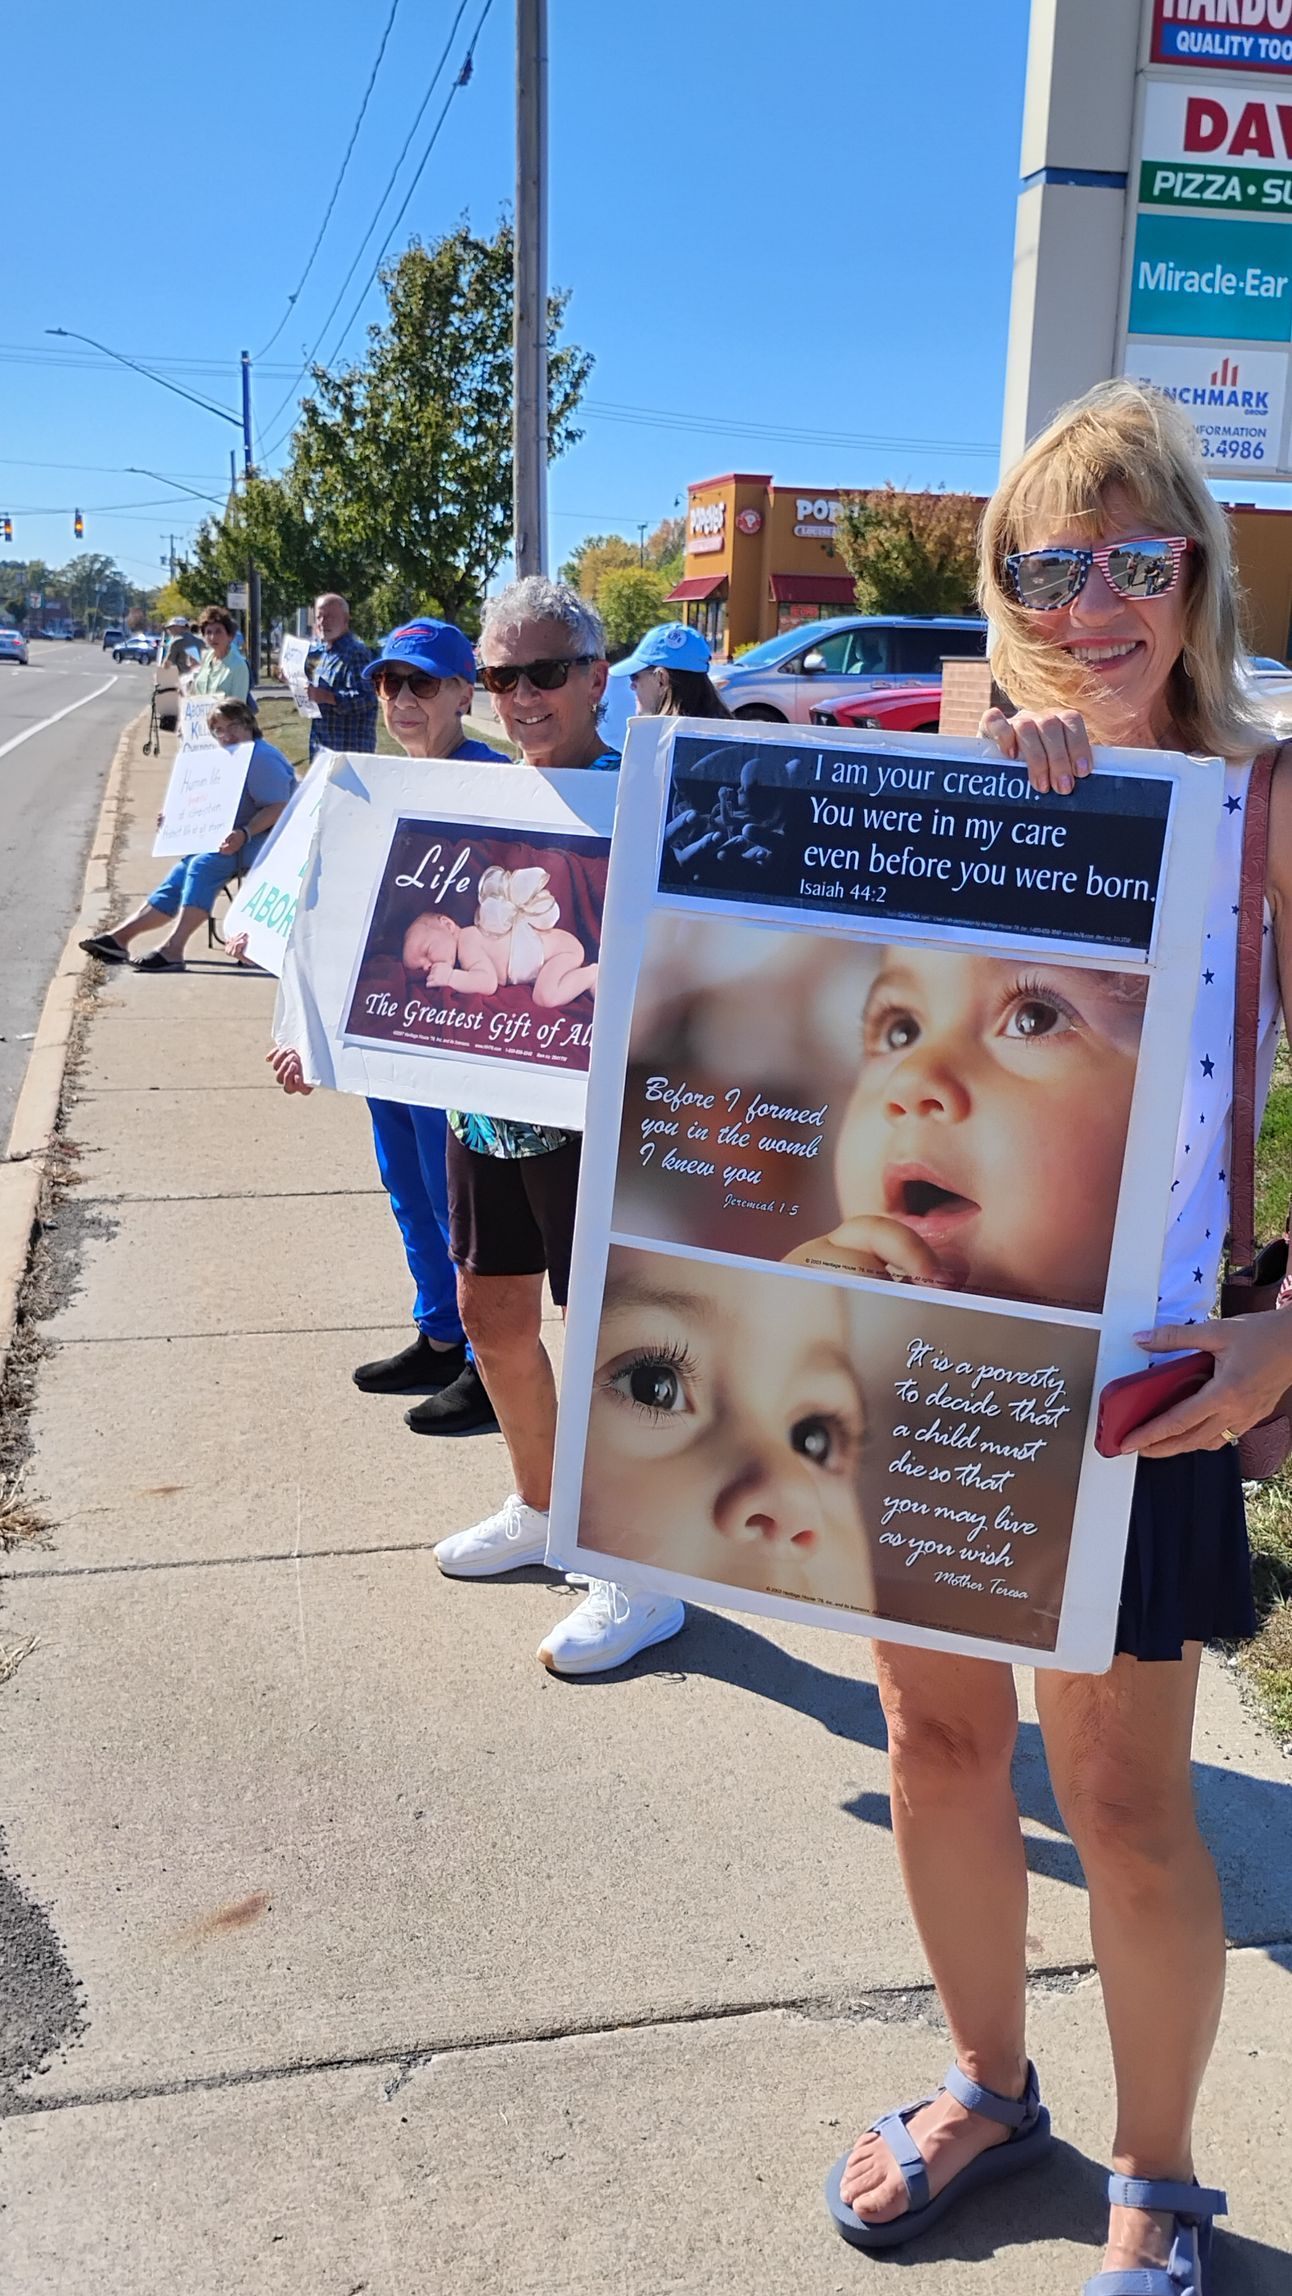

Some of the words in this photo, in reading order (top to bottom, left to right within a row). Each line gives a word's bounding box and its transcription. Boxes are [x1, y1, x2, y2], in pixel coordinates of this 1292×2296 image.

[1176, 30, 1255, 57] QUALITY
[1152, 170, 1242, 202] PIZZA
[1148, 384, 1269, 409] NCHMARK
[815, 754, 823, 780] I
[831, 761, 868, 785] am
[869, 766, 935, 797] your
[811, 796, 854, 827] You
[864, 808, 922, 833] were
[931, 809, 955, 836] in
[965, 817, 1003, 851] my
[1011, 823, 1067, 848] care
[395, 844, 471, 904] Life
[800, 878, 844, 898] Isaiah
[850, 884, 887, 902] 44:2
[804, 845, 860, 870] even
[869, 843, 951, 880] before
[951, 861, 1006, 892] you
[1016, 867, 1077, 893] were
[1086, 865, 1155, 902] born.
[365, 992, 398, 1017] The
[402, 1000, 484, 1030] Greatest
[488, 1012, 531, 1042] Gift
[536, 1018, 566, 1048] of
[560, 1022, 593, 1047] Al
[645, 1076, 715, 1112] Before
[724, 1088, 741, 1112] I
[745, 1094, 829, 1126] formed
[640, 1118, 679, 1139] you
[687, 1121, 709, 1140] in
[717, 1122, 751, 1147] the
[758, 1135, 824, 1158] womb
[639, 1142, 656, 1166] I
[661, 1148, 715, 1176] knew
[723, 1166, 762, 1187] you
[723, 1193, 775, 1212] Jeremiah
[906, 1338, 935, 1368] It
[930, 1349, 954, 1370] is
[955, 1362, 973, 1374] a
[971, 1364, 1066, 1407] poverty
[894, 1378, 920, 1402] to
[925, 1382, 1001, 1416] decide
[1008, 1398, 1070, 1428] that
[892, 1424, 910, 1437] a
[914, 1418, 981, 1448] child
[980, 1439, 1047, 1461] must
[889, 1450, 927, 1477] die
[928, 1467, 951, 1483] so
[954, 1463, 1015, 1492] that
[880, 1496, 931, 1525] you
[934, 1506, 988, 1541] may
[994, 1505, 1038, 1535] live
[879, 1532, 907, 1546] as
[905, 1537, 955, 1566] you
[959, 1542, 1013, 1567] wish
[934, 1571, 984, 1592] Mother
[990, 1578, 1029, 1599] Teresa
